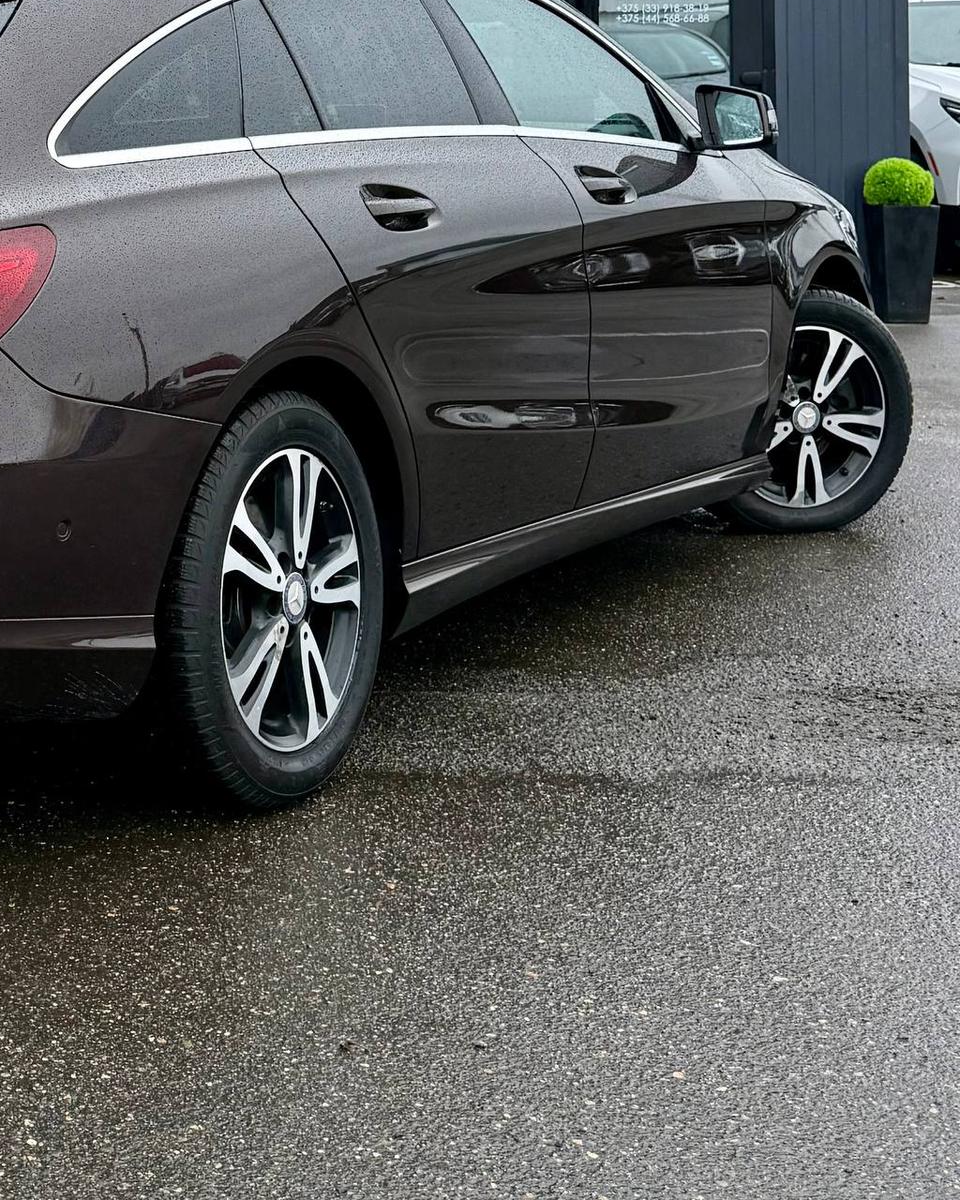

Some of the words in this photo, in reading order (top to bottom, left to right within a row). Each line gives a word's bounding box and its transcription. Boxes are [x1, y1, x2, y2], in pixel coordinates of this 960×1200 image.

[616, 4, 639, 13] +375
[642, 4, 659, 14] (33)
[616, 14, 639, 23] +375
[642, 14, 659, 25] (44)
[663, 14, 709, 23] 568-66-88
